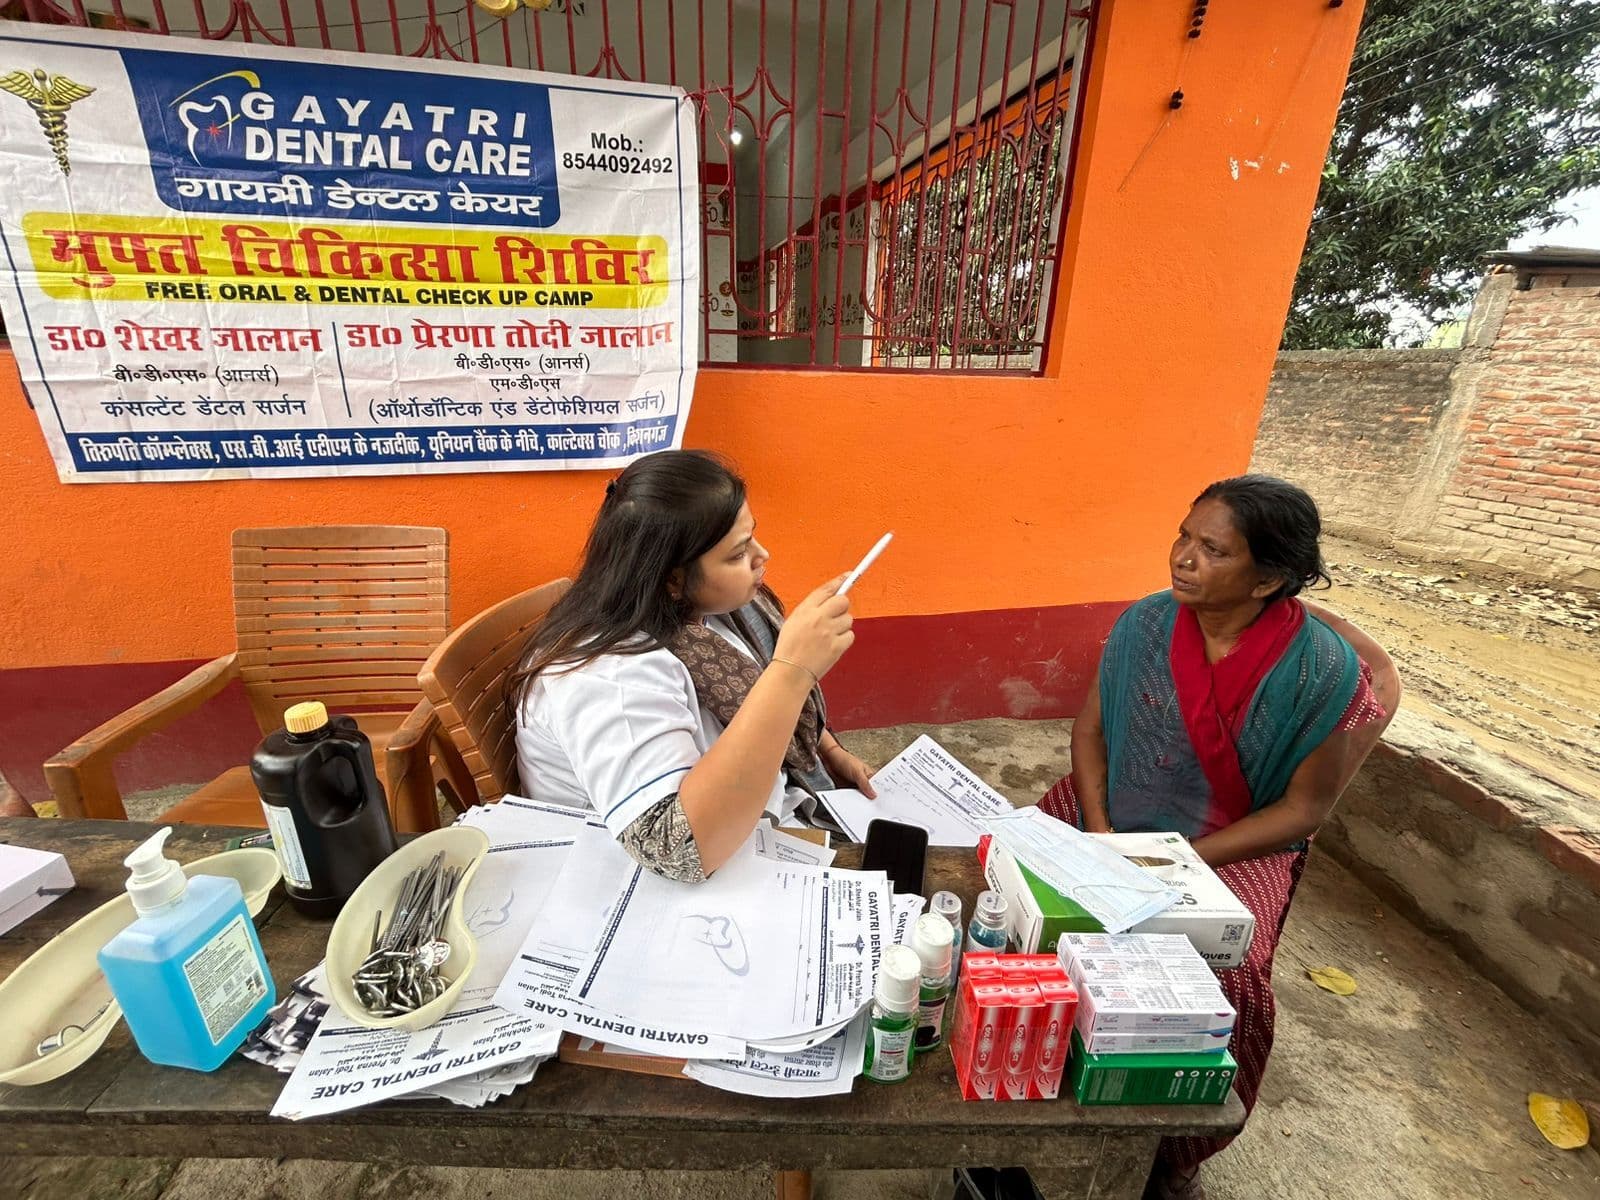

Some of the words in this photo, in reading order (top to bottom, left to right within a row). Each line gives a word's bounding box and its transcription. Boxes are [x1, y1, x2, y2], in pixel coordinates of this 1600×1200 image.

[240, 91, 527, 138] GAYATRI
[246, 127, 412, 171] DENTAL
[425, 138, 531, 177] CARE
[591, 132, 644, 153] Mob.:
[562, 153, 673, 174] 8544092492
[174, 174, 313, 206] गायत्री
[324, 178, 441, 212] डेन्टल
[447, 182, 542, 216] केयर
[42, 230, 208, 288] मुफ्त
[221, 224, 480, 282] चिकित्सा
[494, 236, 656, 286] शिविर
[146, 281, 211, 300] FREE
[220, 283, 286, 301] ORAL
[294, 285, 312, 302] &
[319, 286, 409, 304] DENTAL
[416, 288, 493, 305] CHECK
[499, 289, 527, 305] UP
[534, 290, 594, 307] CAMP
[115, 319, 203, 352] शेखर
[211, 327, 323, 353] जालान
[411, 318, 495, 350] प्रेरणा
[503, 319, 571, 349] तोदी
[579, 321, 674, 348] जालान
[539, 353, 591, 373] (आनर्स)
[215, 364, 280, 387] (आनर्स)
[101, 395, 187, 416] कंसल्टेंट
[192, 395, 247, 416] डेंटल
[252, 394, 307, 416] सर्जन
[489, 398, 516, 418] एंड
[523, 396, 620, 415] डेंटोफेशियल
[626, 390, 666, 413] सर्जन)
[221, 433, 304, 460] एस.बी.आई
[306, 433, 351, 457] एटीएम
[352, 432, 369, 456] के
[369, 432, 425, 458] नजदीक,
[427, 431, 474, 460] यूनियन
[474, 429, 498, 452] बैंक
[499, 429, 513, 452] के
[514, 429, 545, 456] नीचे,
[597, 427, 621, 450] चौक
[929, 748, 956, 773] GAYATRI
[955, 769, 981, 794] DENTAL
[981, 790, 1001, 807] CARE
[868, 891, 880, 931] GAYATRI
[893, 911, 908, 945] GAYAT
[870, 933, 881, 971] DENTAL
[524, 998, 569, 1018] CARE
[500, 1025, 533, 1039] Shekhar
[574, 1012, 636, 1036] DENTAL
[472, 1035, 498, 1046] Jalan
[640, 1028, 709, 1046] GAYATRI
[357, 1059, 387, 1070] Prerna
[390, 1057, 402, 1065] Dr.
[446, 1041, 522, 1067] GAYATRI
[308, 1067, 334, 1077] Jalan
[334, 1065, 354, 1075] Todi
[372, 1063, 443, 1088] DENTAL
[310, 1081, 365, 1100] CARE
